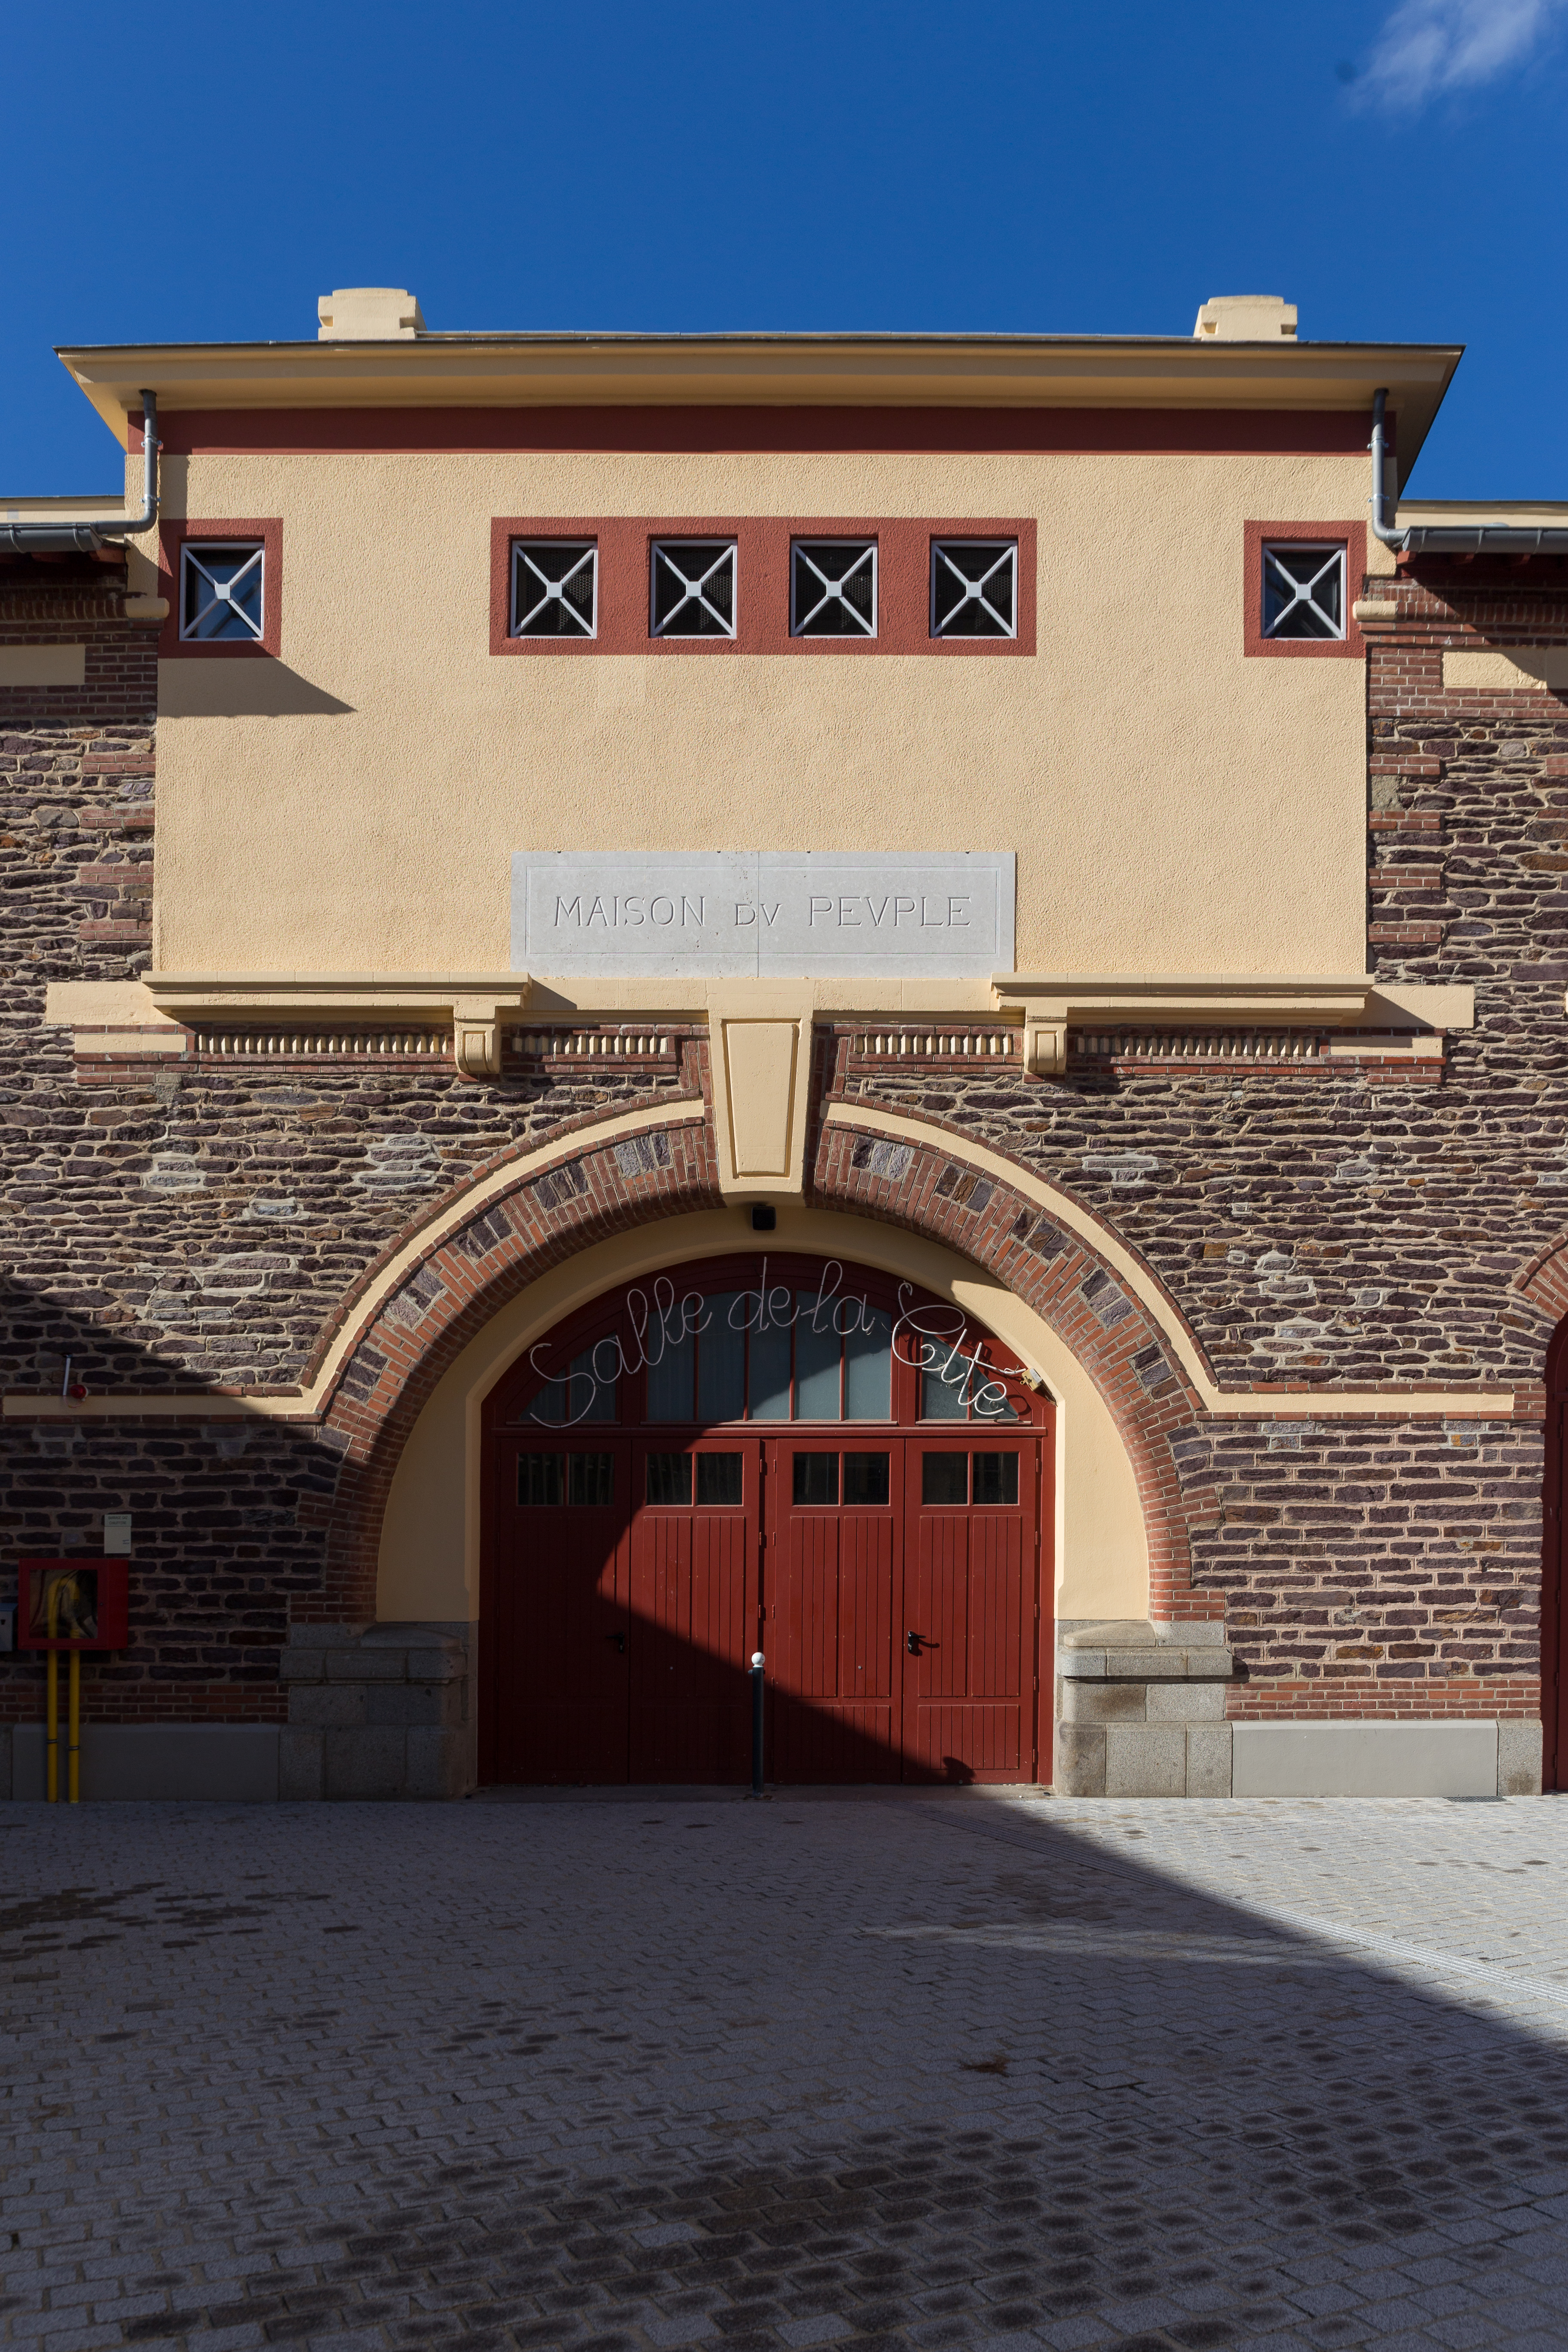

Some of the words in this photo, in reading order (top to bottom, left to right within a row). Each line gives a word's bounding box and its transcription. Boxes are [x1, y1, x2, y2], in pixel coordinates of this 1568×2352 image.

[553, 896, 706, 927] MAISON
[808, 896, 973, 927] PEVPLE
[529, 1277, 713, 1428] Salle
[728, 1256, 800, 1332] de
[801, 1260, 876, 1335] la
